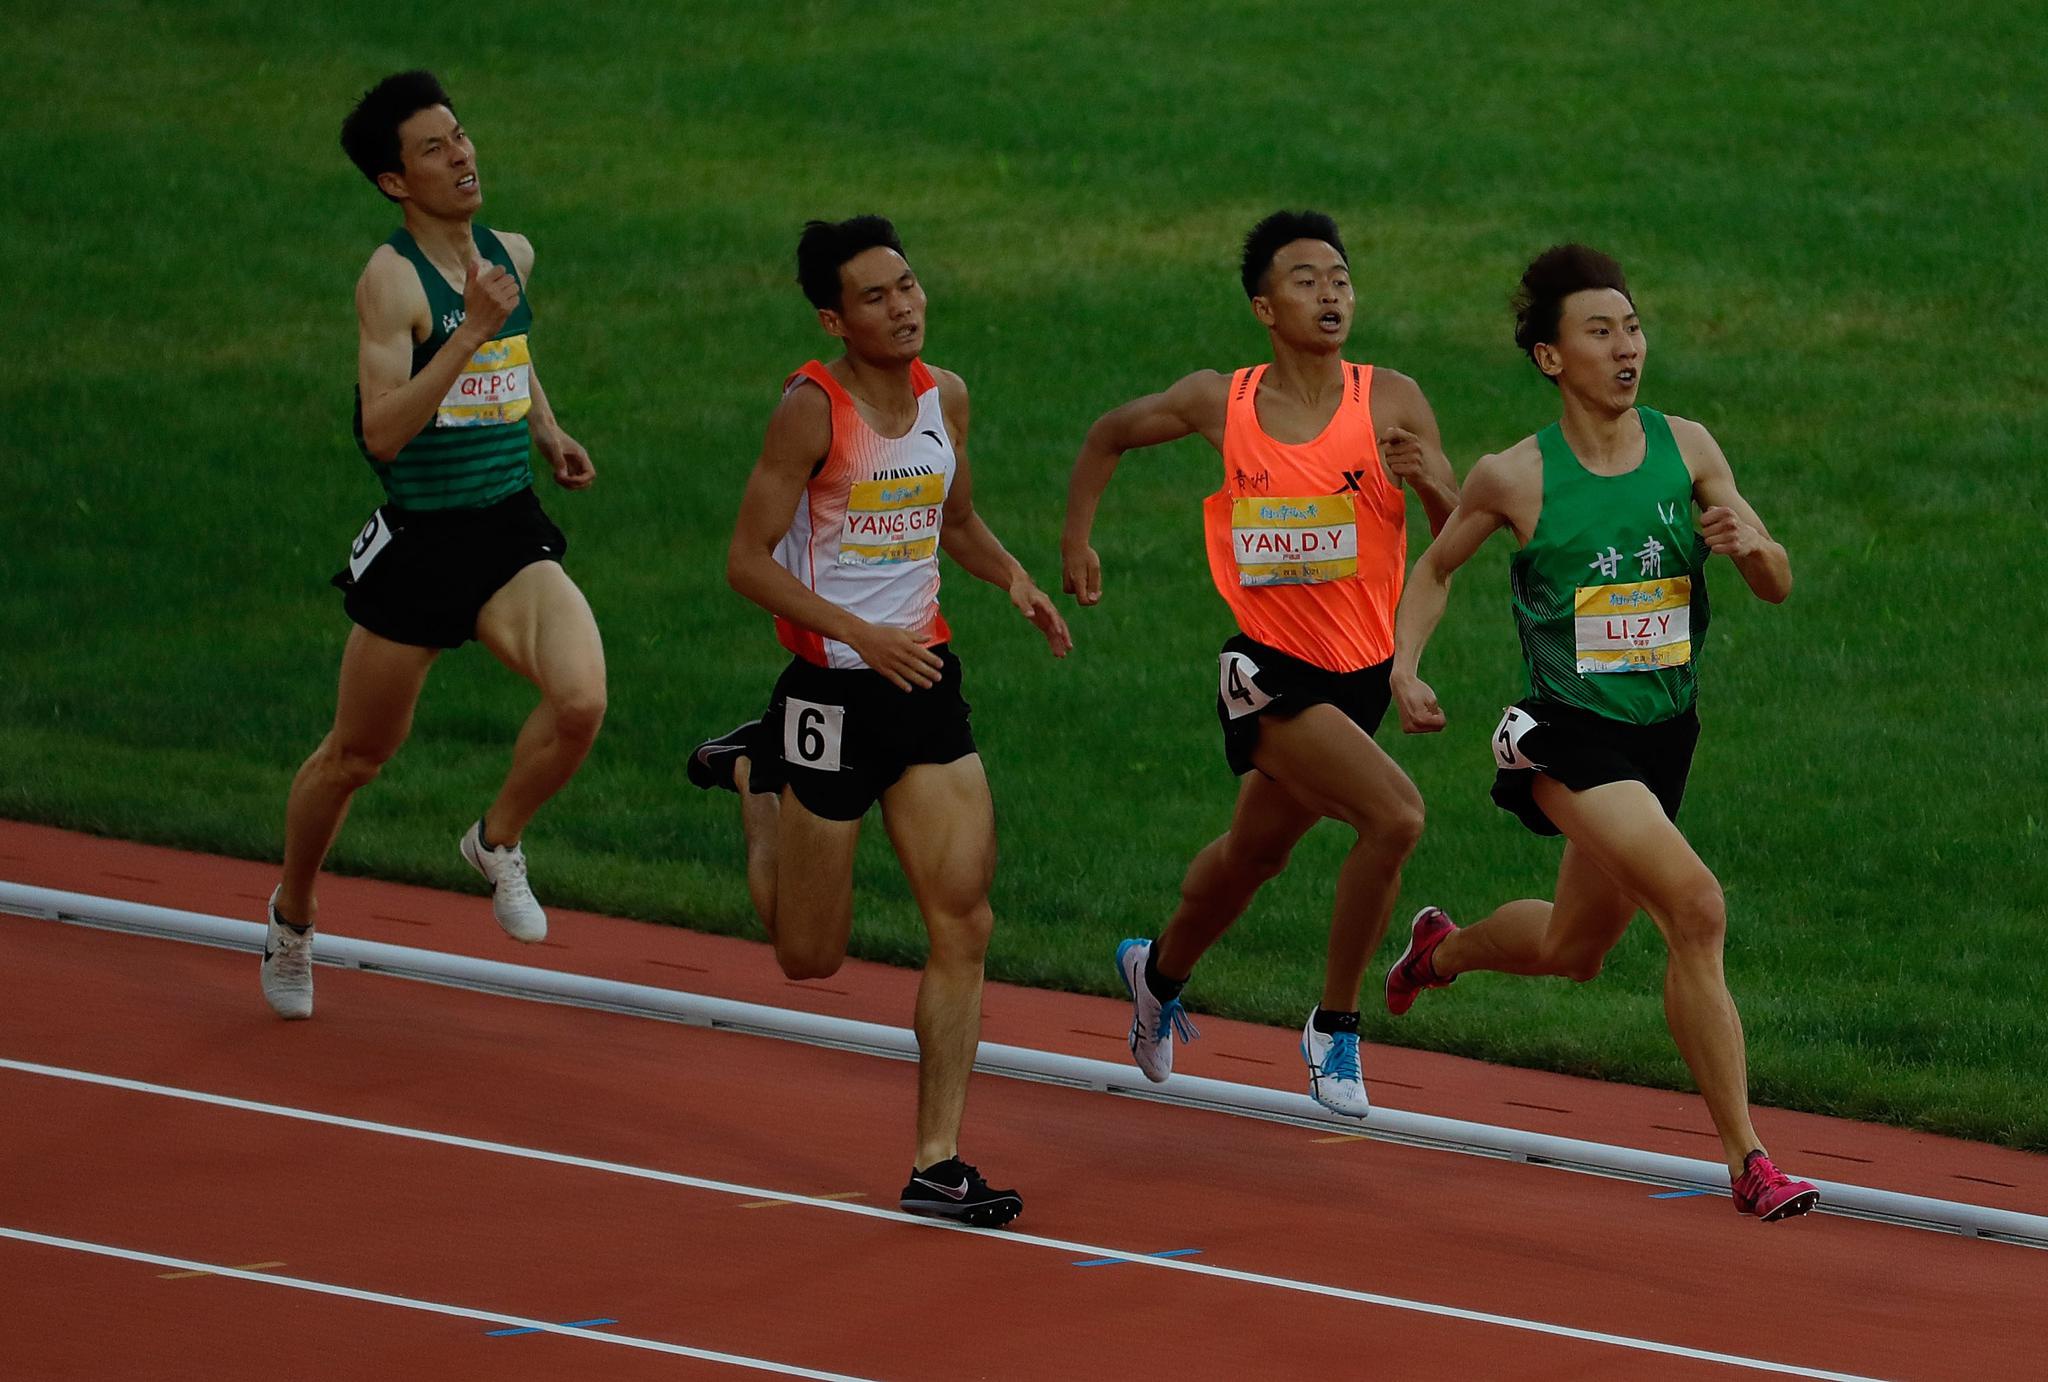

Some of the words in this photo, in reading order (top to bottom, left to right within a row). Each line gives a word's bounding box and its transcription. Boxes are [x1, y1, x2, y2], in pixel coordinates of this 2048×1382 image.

[461, 372, 515, 396] QI.P.C
[848, 508, 938, 535] YANG.G.B
[1240, 529, 1343, 553] YAN.D.Y
[1588, 535, 1665, 579] 甘肃
[1606, 614, 1670, 640] LI.Z.Y
[1228, 657, 1255, 706] 4
[797, 708, 825, 761] 6
[1498, 712, 1519, 764] 5
